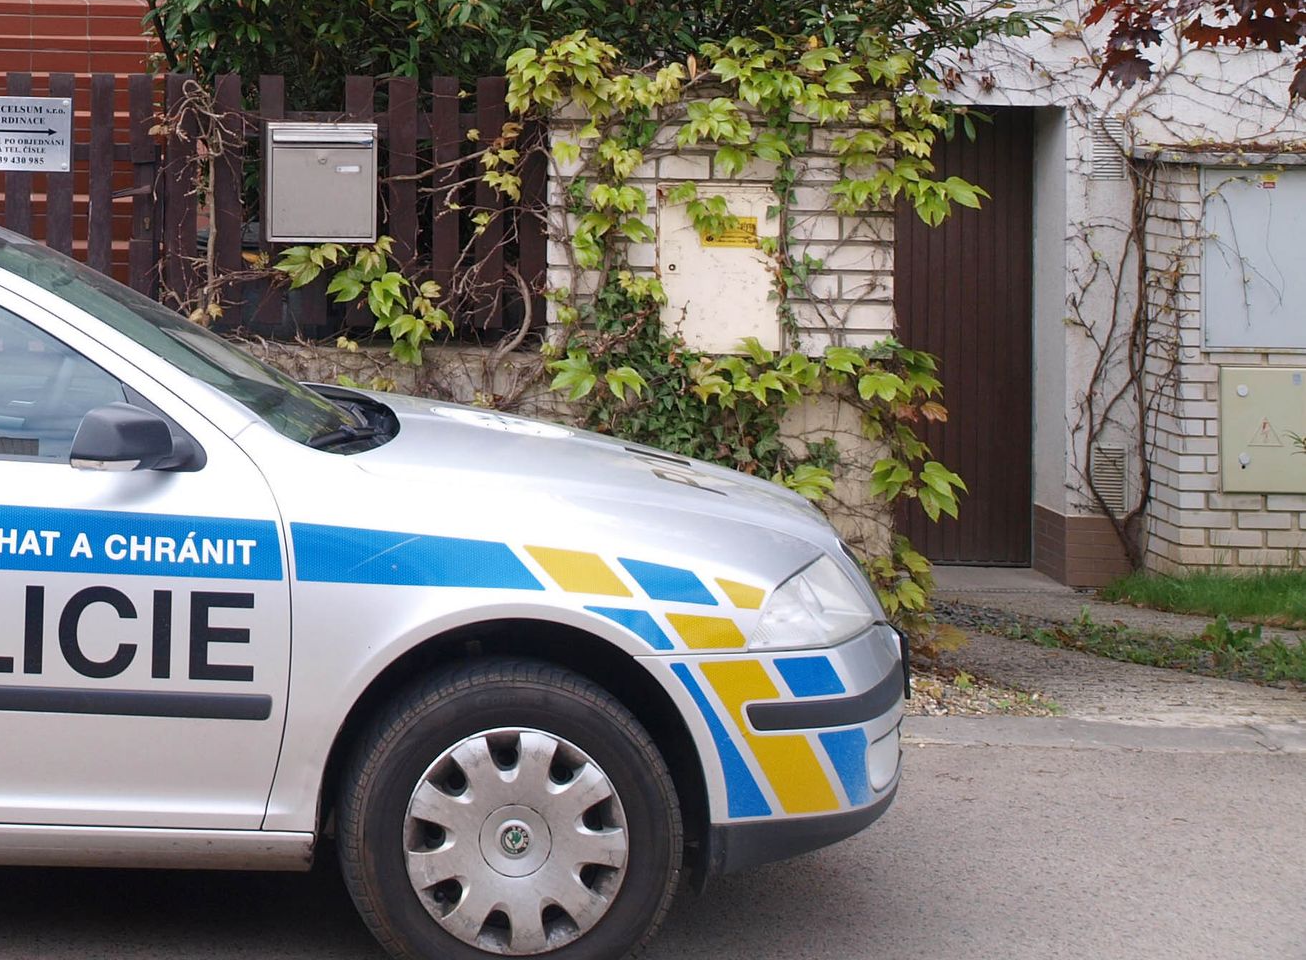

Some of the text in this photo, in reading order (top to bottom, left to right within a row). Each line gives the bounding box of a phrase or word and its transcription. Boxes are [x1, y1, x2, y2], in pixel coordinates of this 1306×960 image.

[4, 137, 16, 145] PO
[5, 146, 22, 154] TEL.
[10, 156, 26, 164] 430
[28, 156, 45, 165] 985
[70, 532, 94, 559] A
[104, 530, 257, 565] CHRÁNIT
